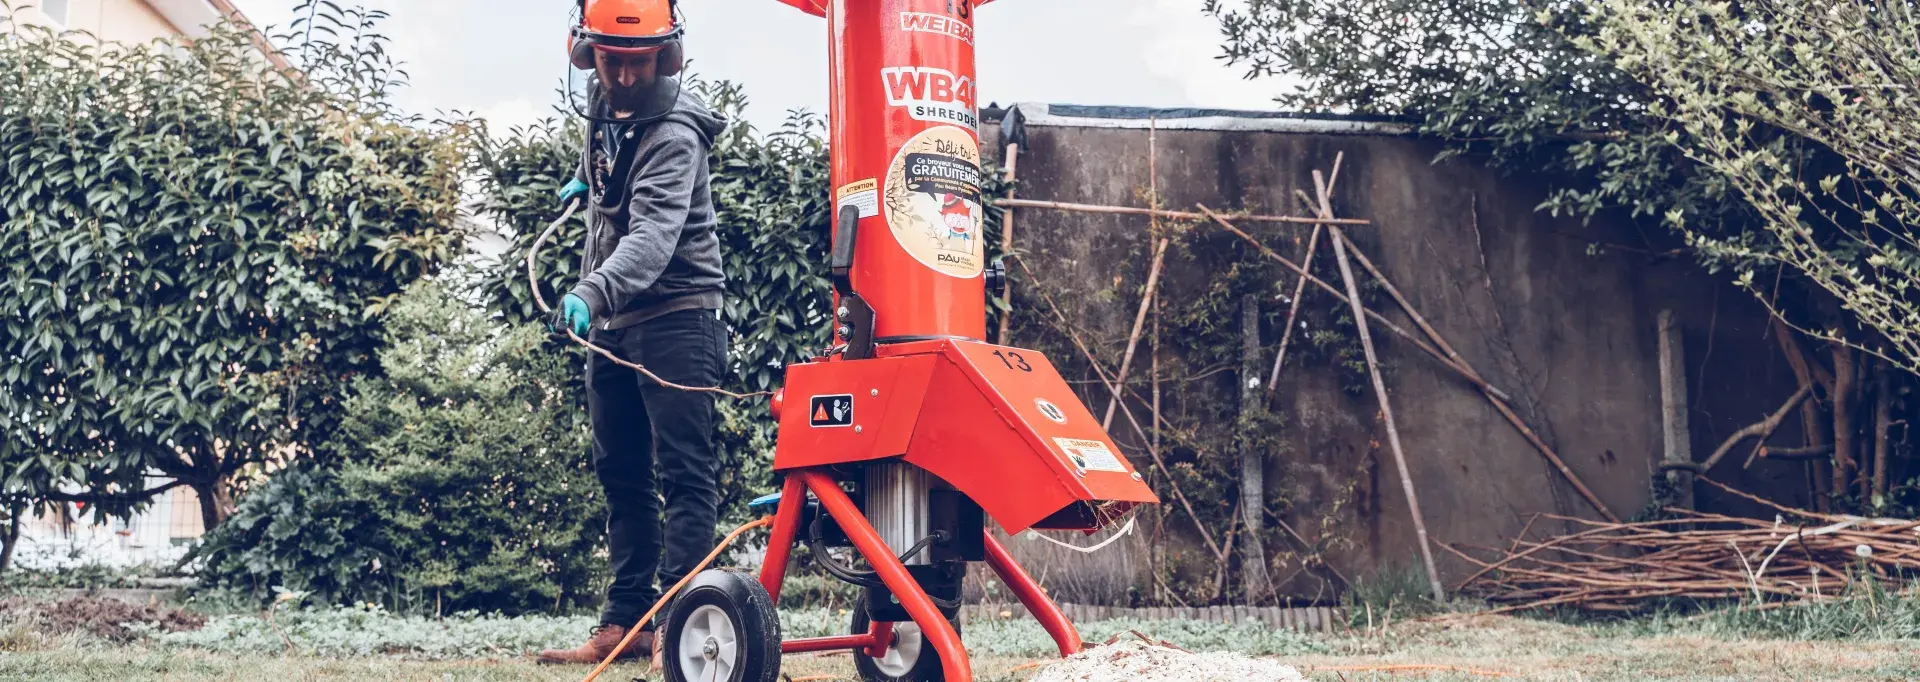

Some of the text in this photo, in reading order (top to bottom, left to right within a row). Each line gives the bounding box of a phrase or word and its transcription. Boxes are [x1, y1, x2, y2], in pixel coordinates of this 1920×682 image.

[912, 164, 980, 187] GRATUITEMENT
[846, 181, 874, 193] ATTENTION
[992, 350, 1032, 372] 13
